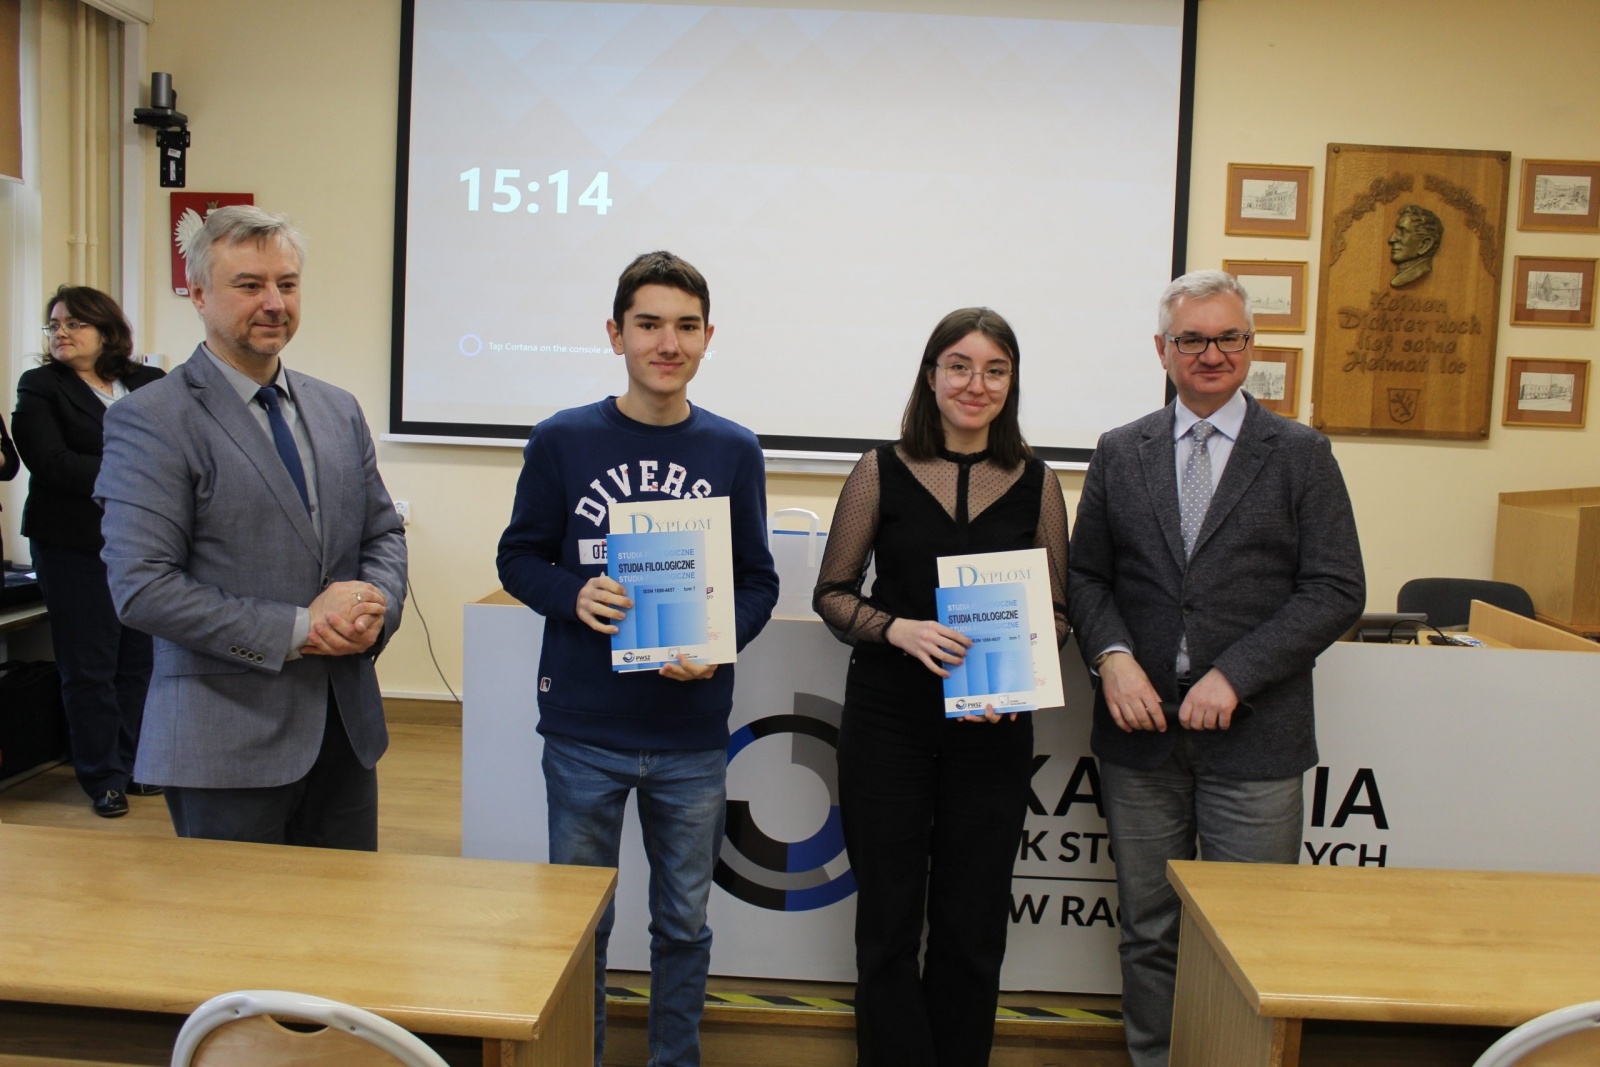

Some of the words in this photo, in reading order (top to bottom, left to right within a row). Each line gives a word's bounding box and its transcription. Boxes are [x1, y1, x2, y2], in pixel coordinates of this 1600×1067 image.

[460, 167, 613, 215] 15:14
[1370, 290, 1448, 313] Keinen
[1338, 308, 1429, 332] Dichter
[1435, 315, 1481, 335] noch
[489, 342, 502, 352] Tap
[505, 342, 538, 352] Cortana
[553, 344, 567, 353] the
[568, 345, 601, 354] console
[1402, 337, 1457, 354] seine
[1343, 351, 1429, 373] Heimat
[1440, 356, 1468, 374] los
[628, 512, 711, 534] DYPLOM
[618, 551, 642, 560] STUDIA
[618, 562, 644, 573] STUDIA
[645, 560, 695, 572] FILOLOGICZNE
[955, 564, 1031, 587] DYPLOM
[948, 612, 972, 624] STUDIA
[972, 610, 1019, 622] FILOLOGICZNE
[1009, 894, 1050, 924] W
[1061, 895, 1121, 928] RA
